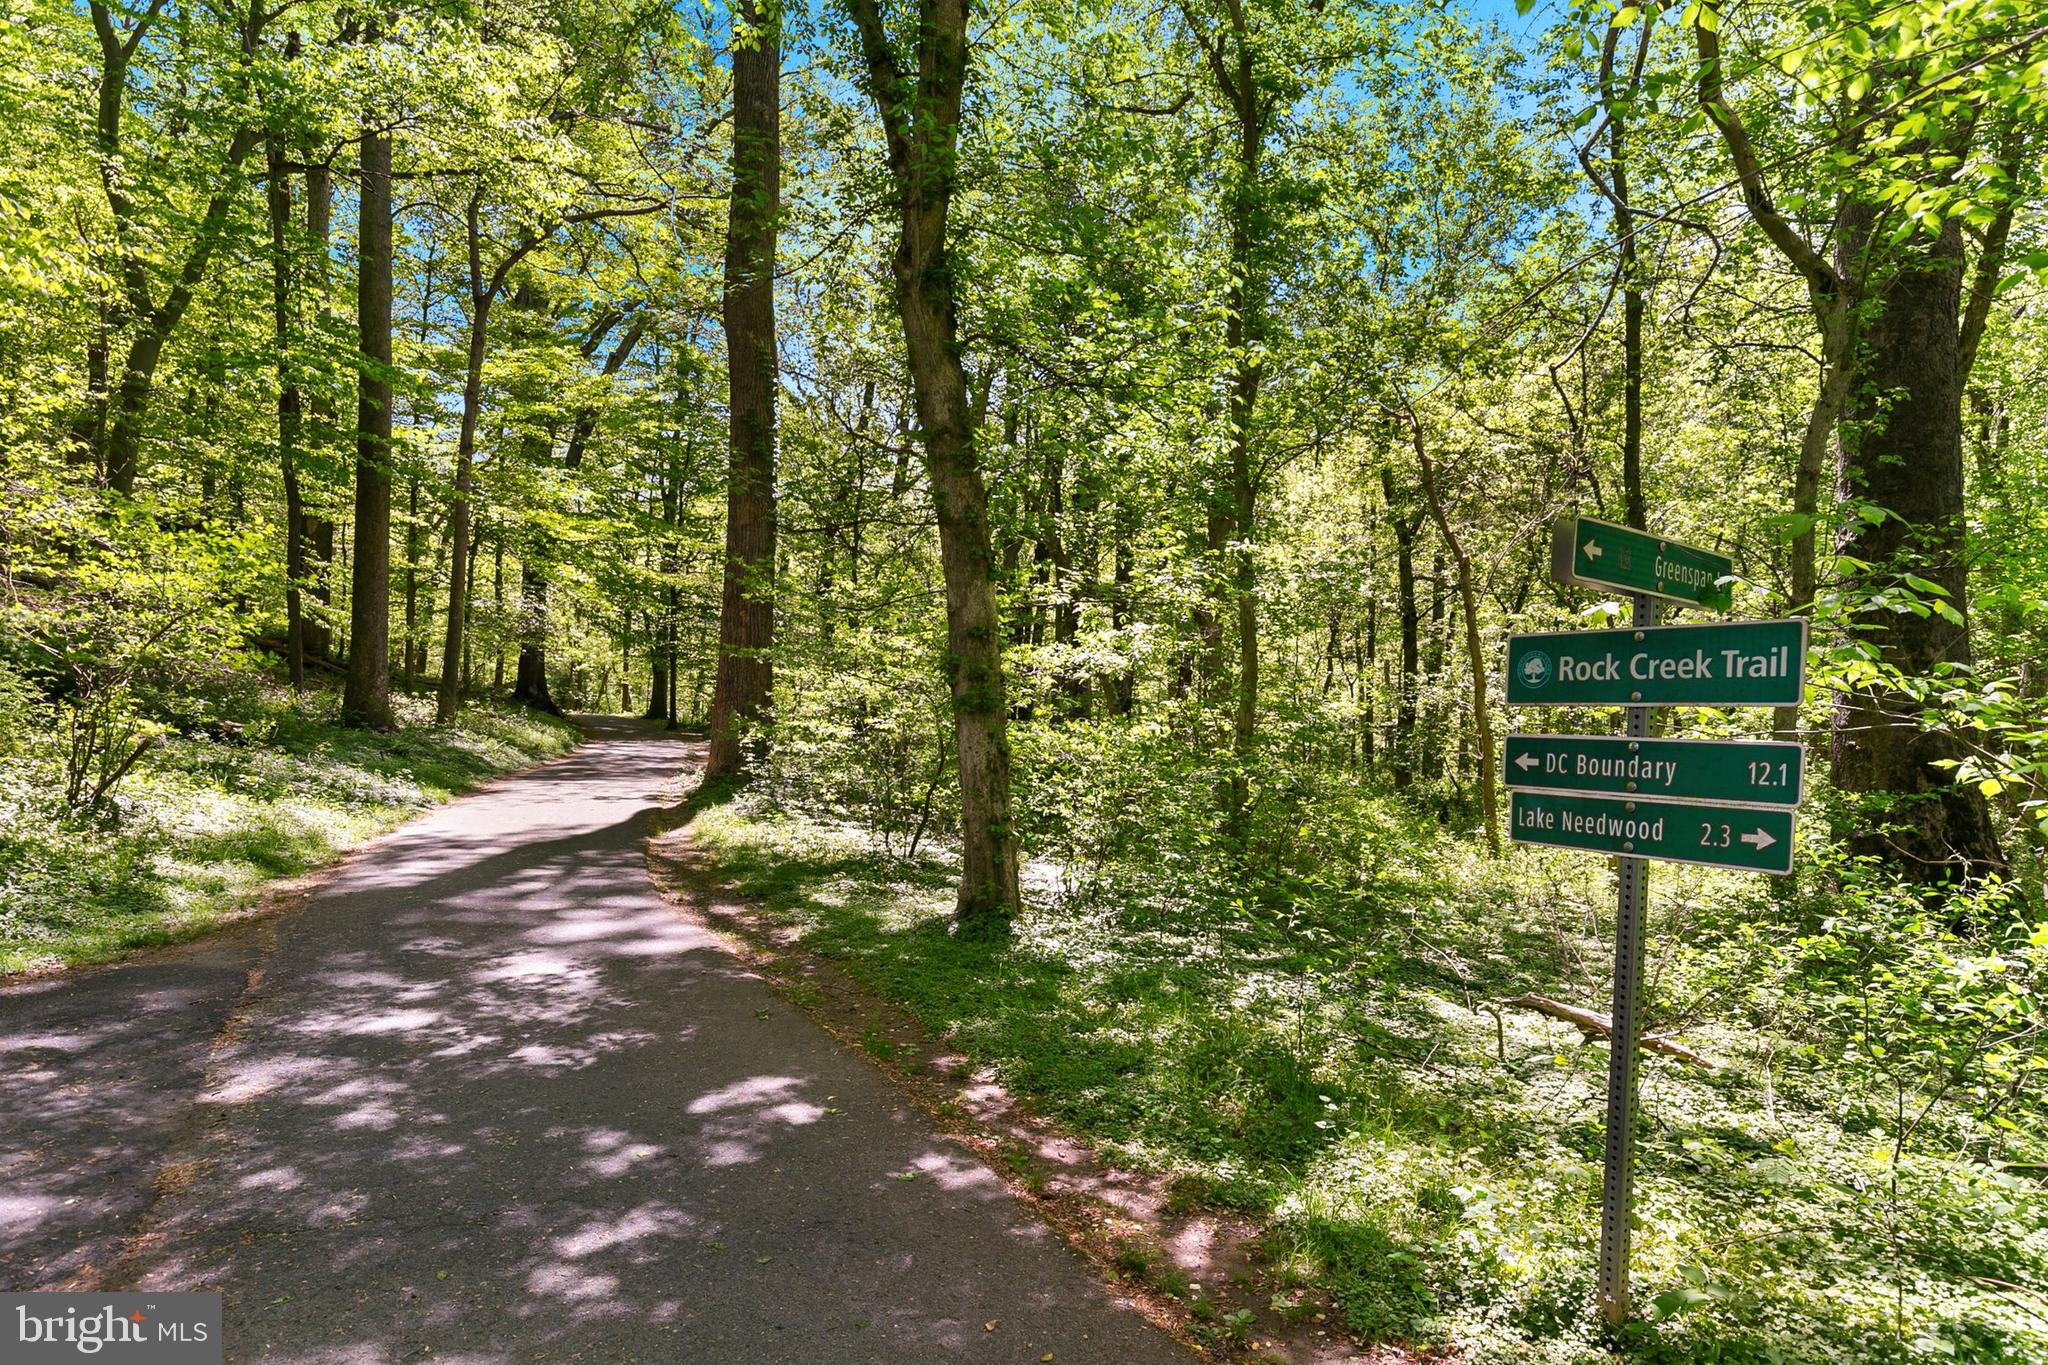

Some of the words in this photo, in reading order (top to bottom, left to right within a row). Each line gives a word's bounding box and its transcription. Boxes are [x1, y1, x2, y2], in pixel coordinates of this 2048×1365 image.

[1558, 653, 1620, 681] Rock
[1630, 650, 1713, 679] Creek
[1721, 646, 1788, 677] Trail
[1546, 753, 1567, 773] DC
[1577, 754, 1676, 786] Boundary
[1748, 762, 1787, 786] 12.1
[1519, 807, 1554, 830] Lake
[1562, 811, 1664, 841] Needwood
[1701, 823, 1730, 847] 2.3
